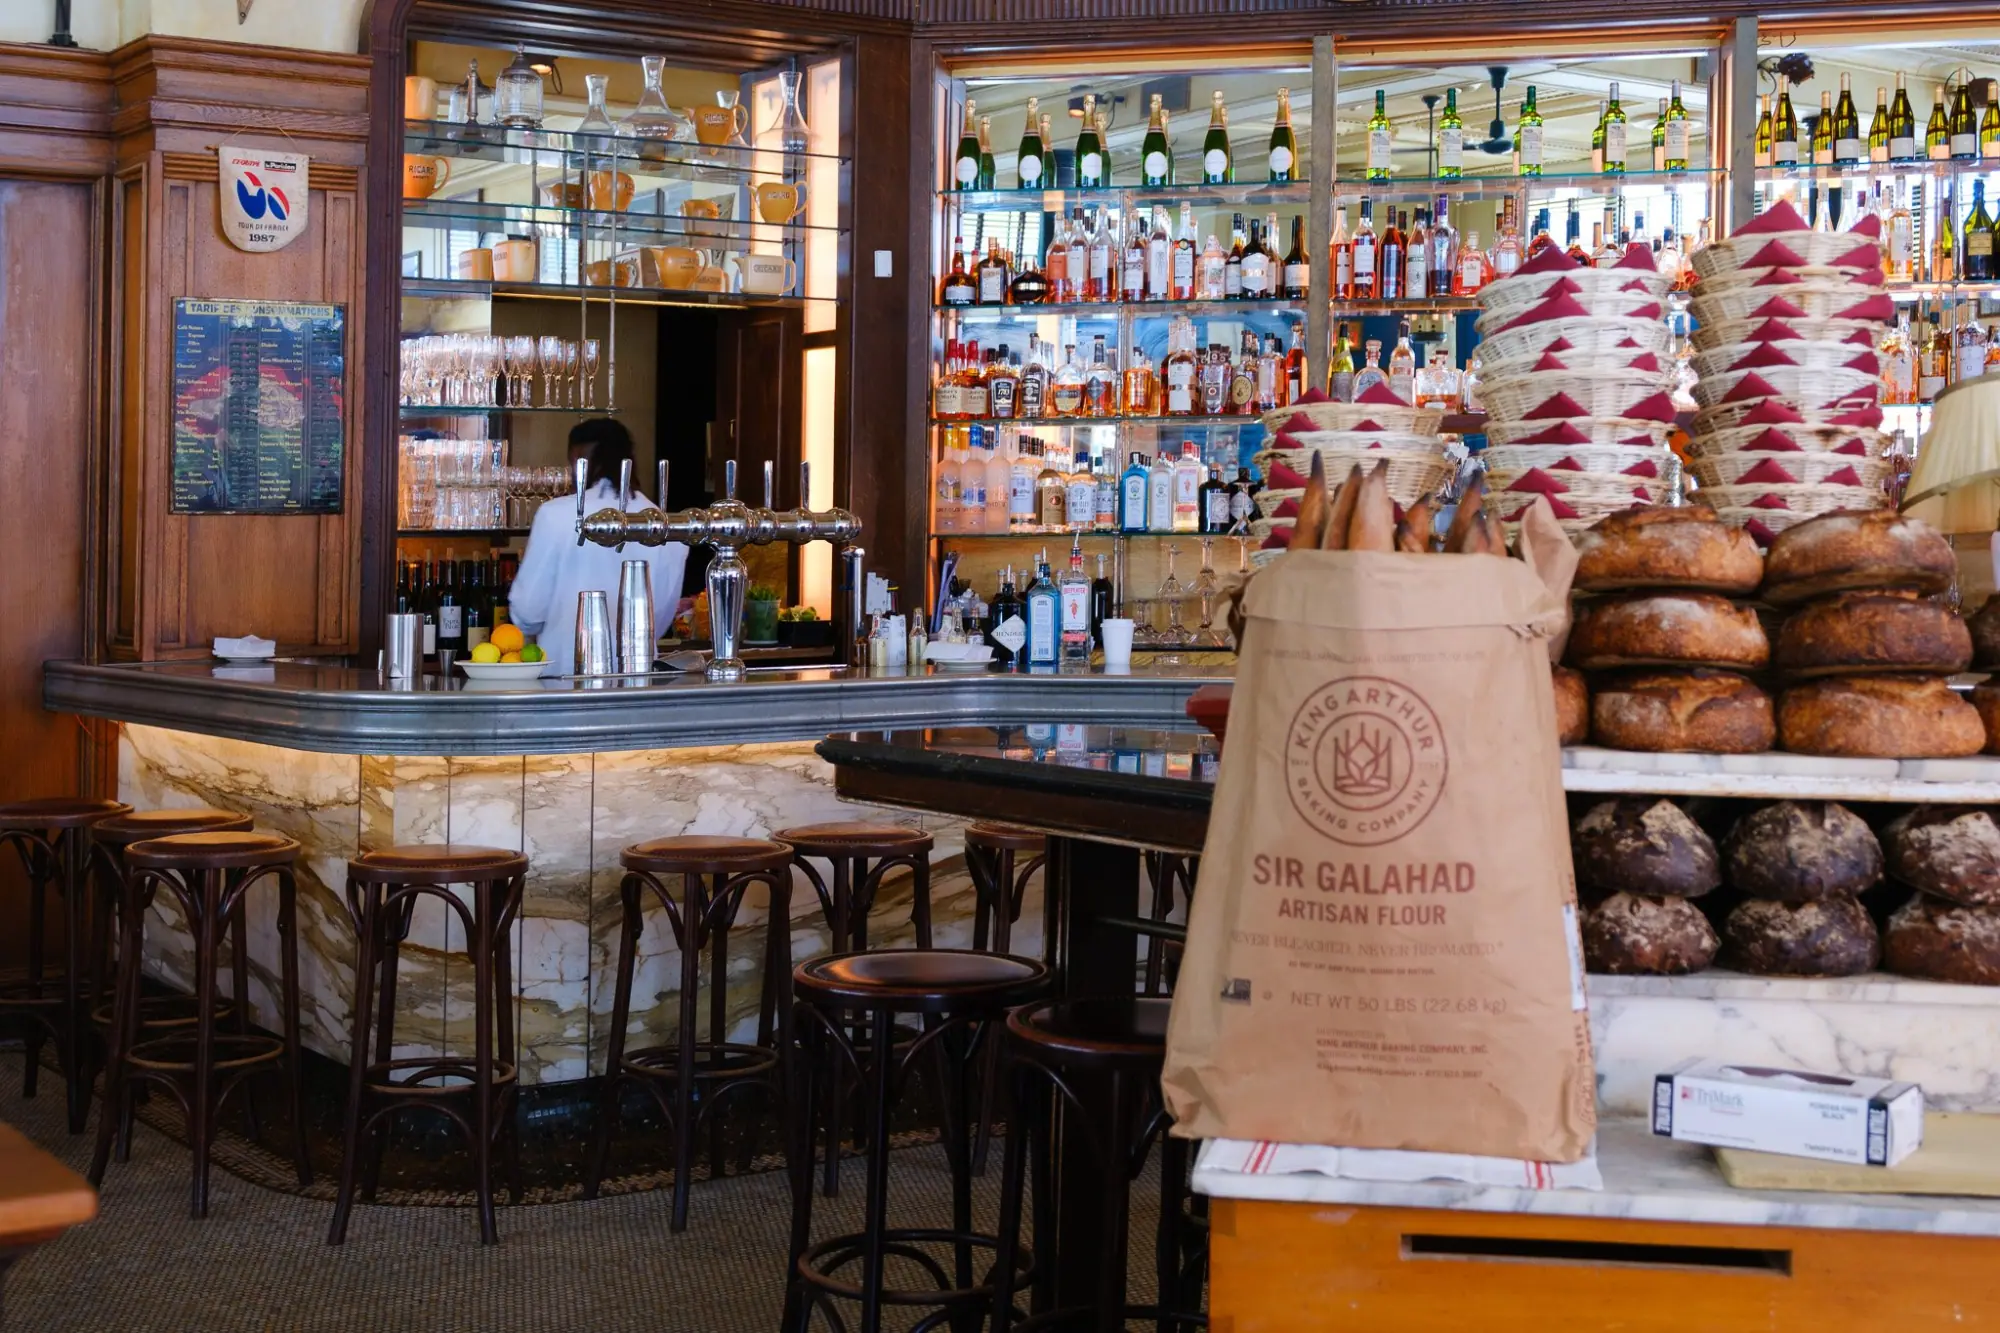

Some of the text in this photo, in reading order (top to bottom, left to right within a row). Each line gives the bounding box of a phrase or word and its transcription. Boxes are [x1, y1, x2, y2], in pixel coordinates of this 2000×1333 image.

[238, 222, 254, 230] TOUR
[264, 224, 289, 232] FRANCE
[249, 233, 276, 243] 1987
[190, 303, 219, 313] TARIF
[1295, 688, 1434, 751] KING ARTHUR
[1297, 777, 1430, 834] BAKING COMPANY
[1253, 853, 1476, 895] SIR GALAHAD
[1278, 897, 1447, 927] ARTISAN FLOUR
[1357, 942, 1409, 959] NEVER
[1290, 991, 1322, 1006] NET
[1329, 994, 1350, 1010] WT
[1357, 996, 1380, 1012] 50
[1385, 997, 1417, 1013] LBS
[1482, 998, 1507, 1016] kg)
[1316, 1038, 1339, 1048] KING
[1341, 1040, 1378, 1051] ARTHUR
[1381, 1043, 1417, 1053] BAKING
[1696, 1087, 1745, 1107] TriMark
